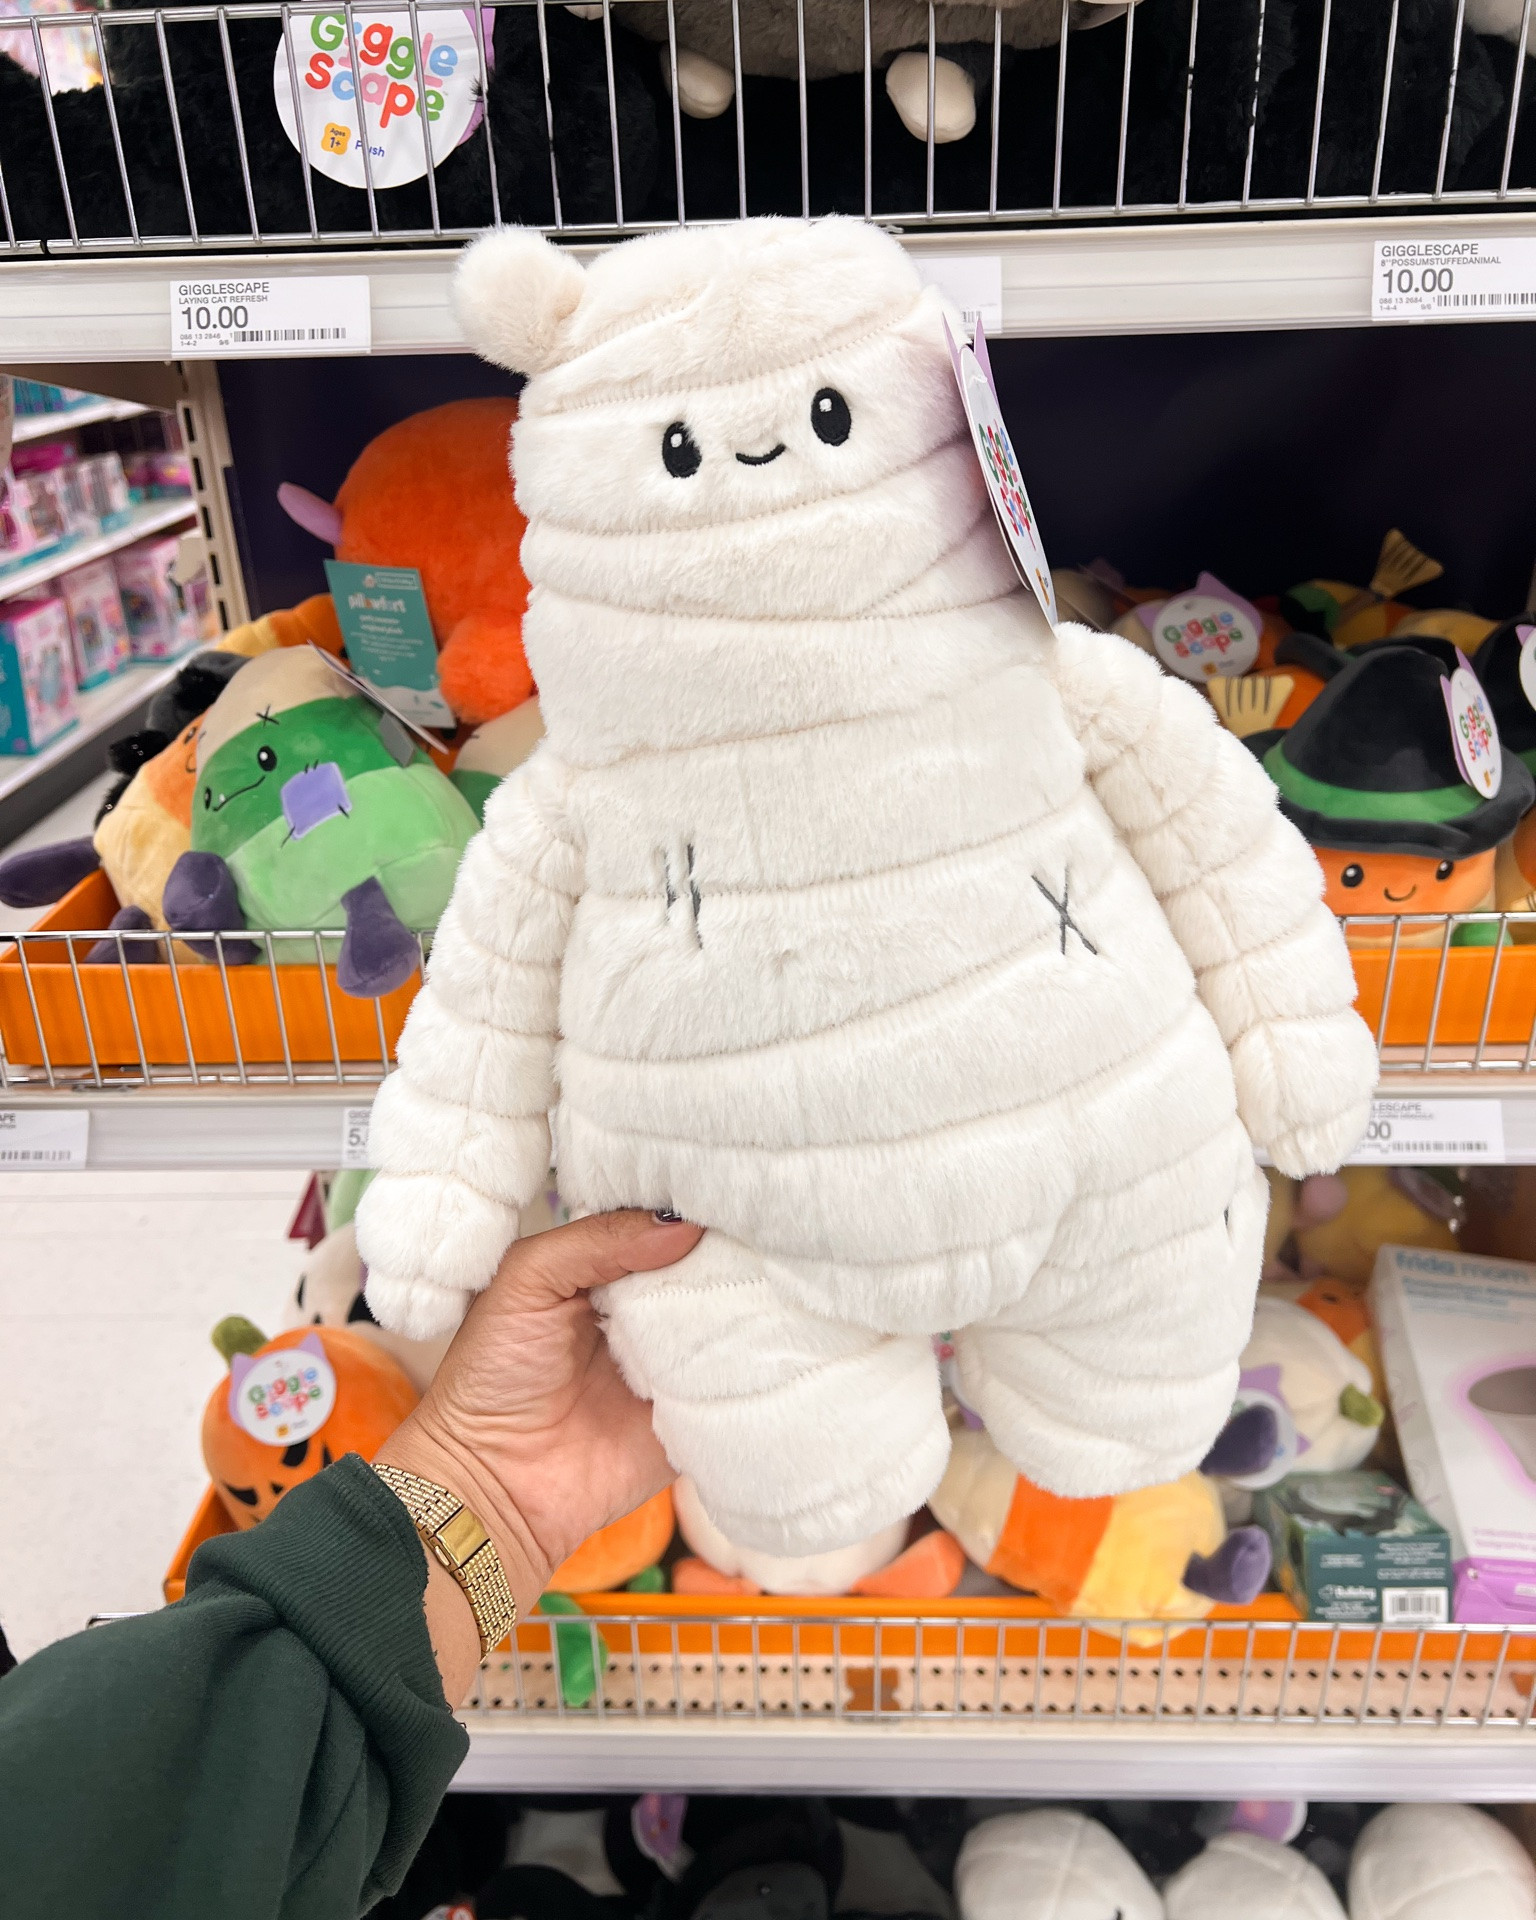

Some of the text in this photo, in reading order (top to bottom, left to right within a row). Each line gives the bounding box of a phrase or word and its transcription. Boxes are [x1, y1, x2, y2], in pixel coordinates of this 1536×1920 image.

[330, 128, 346, 137] Ages
[330, 137, 341, 148] 1+
[1381, 243, 1479, 257] GIGGLESCAPE
[1383, 268, 1453, 293] 10.00
[178, 282, 270, 296] GIGGLESCAPE
[178, 295, 268, 304] LAYING CAT REFRESH
[181, 305, 248, 329] 10.00
